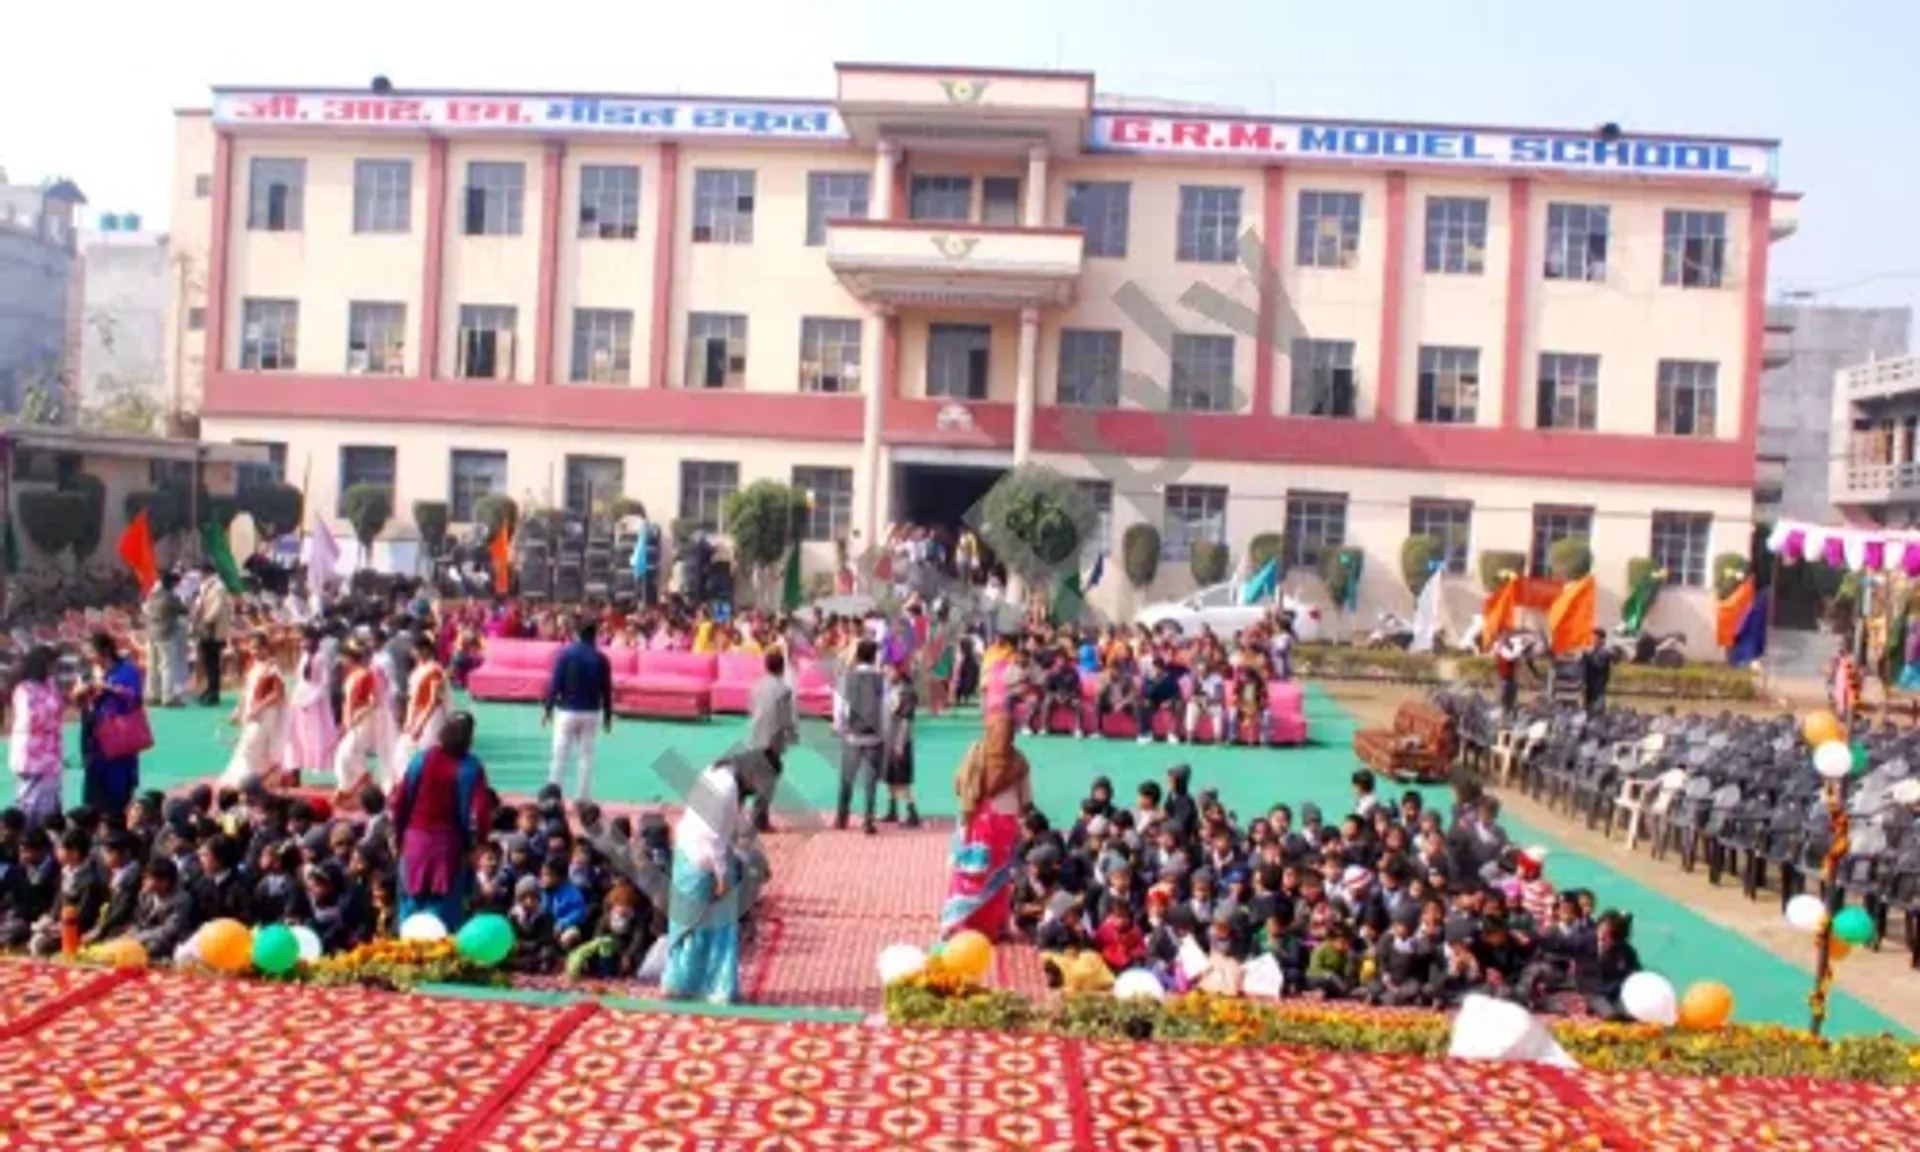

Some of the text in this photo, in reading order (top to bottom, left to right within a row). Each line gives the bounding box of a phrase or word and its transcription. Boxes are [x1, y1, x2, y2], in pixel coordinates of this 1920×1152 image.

[1109, 115, 1753, 172] G.R.M. MODEL SCHOOL
